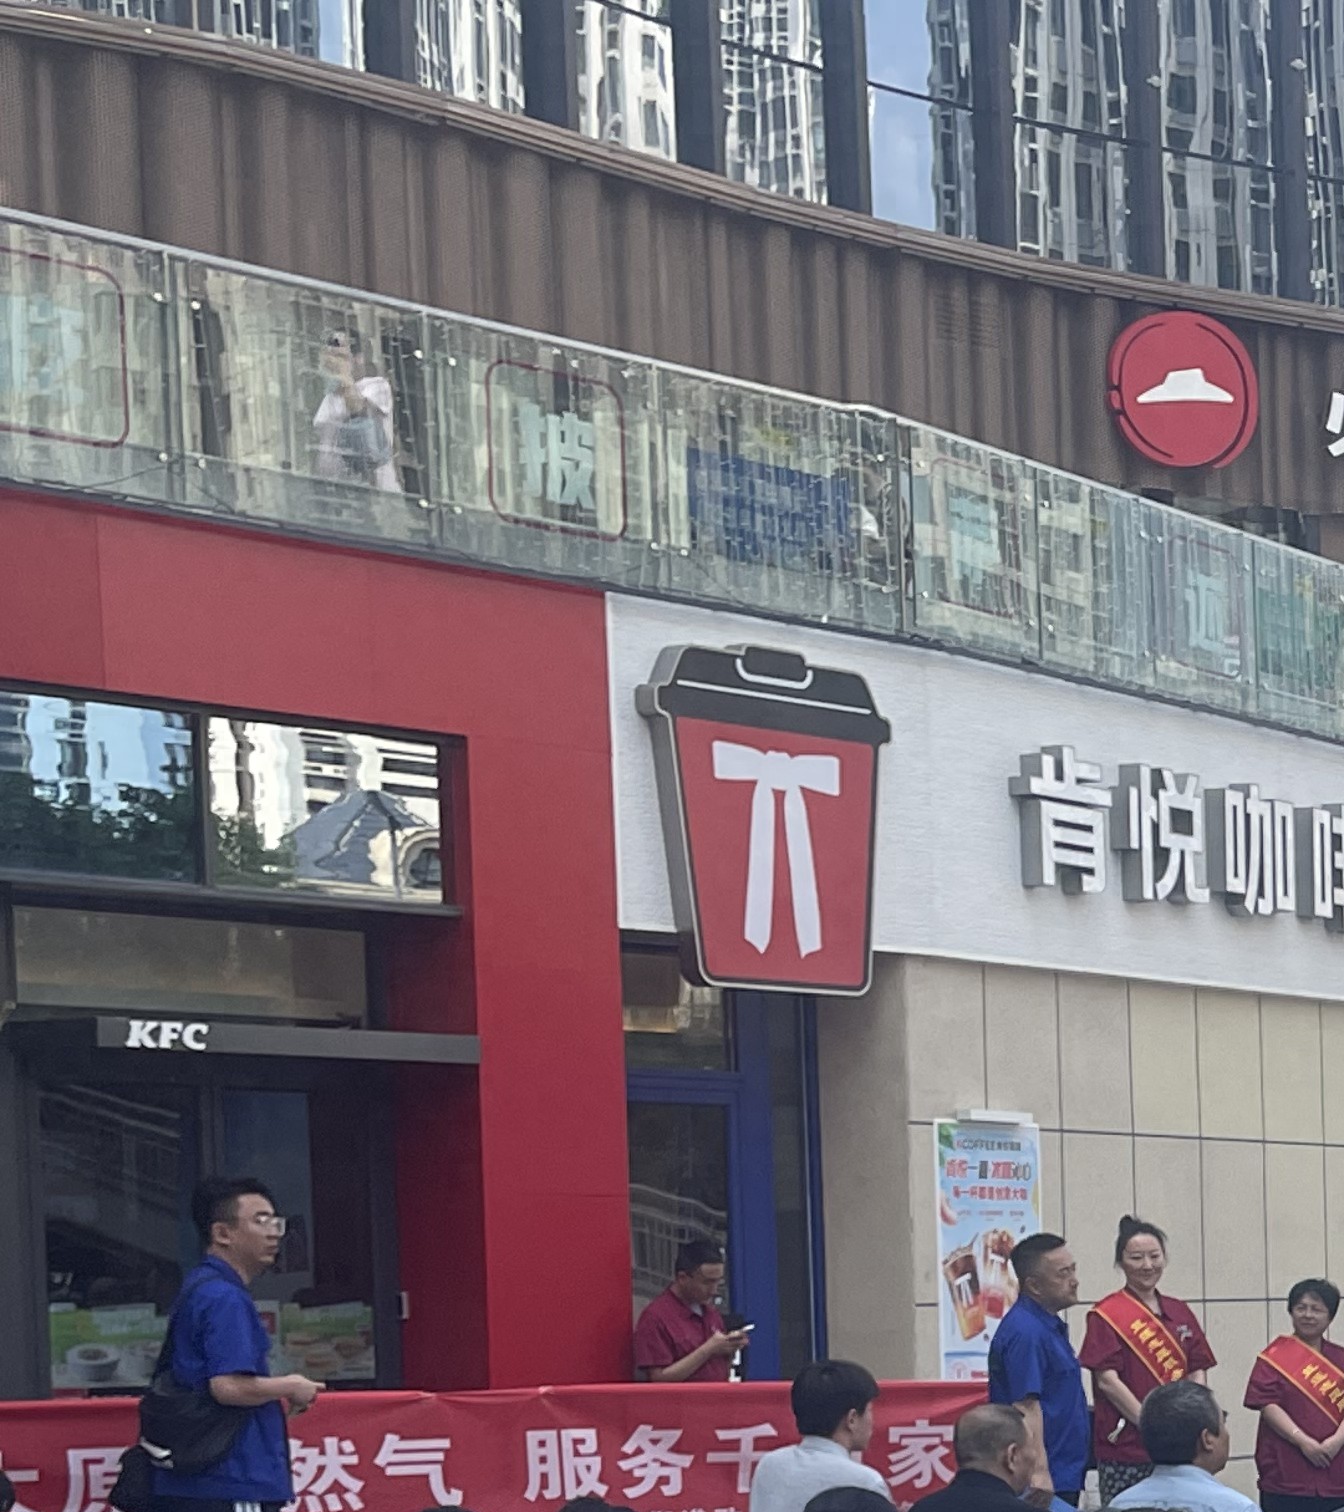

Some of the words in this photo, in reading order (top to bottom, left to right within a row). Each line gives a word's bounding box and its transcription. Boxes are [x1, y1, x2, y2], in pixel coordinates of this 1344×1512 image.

[125, 1020, 210, 1052] KFC
[524, 1419, 957, 1502] 服务千家
